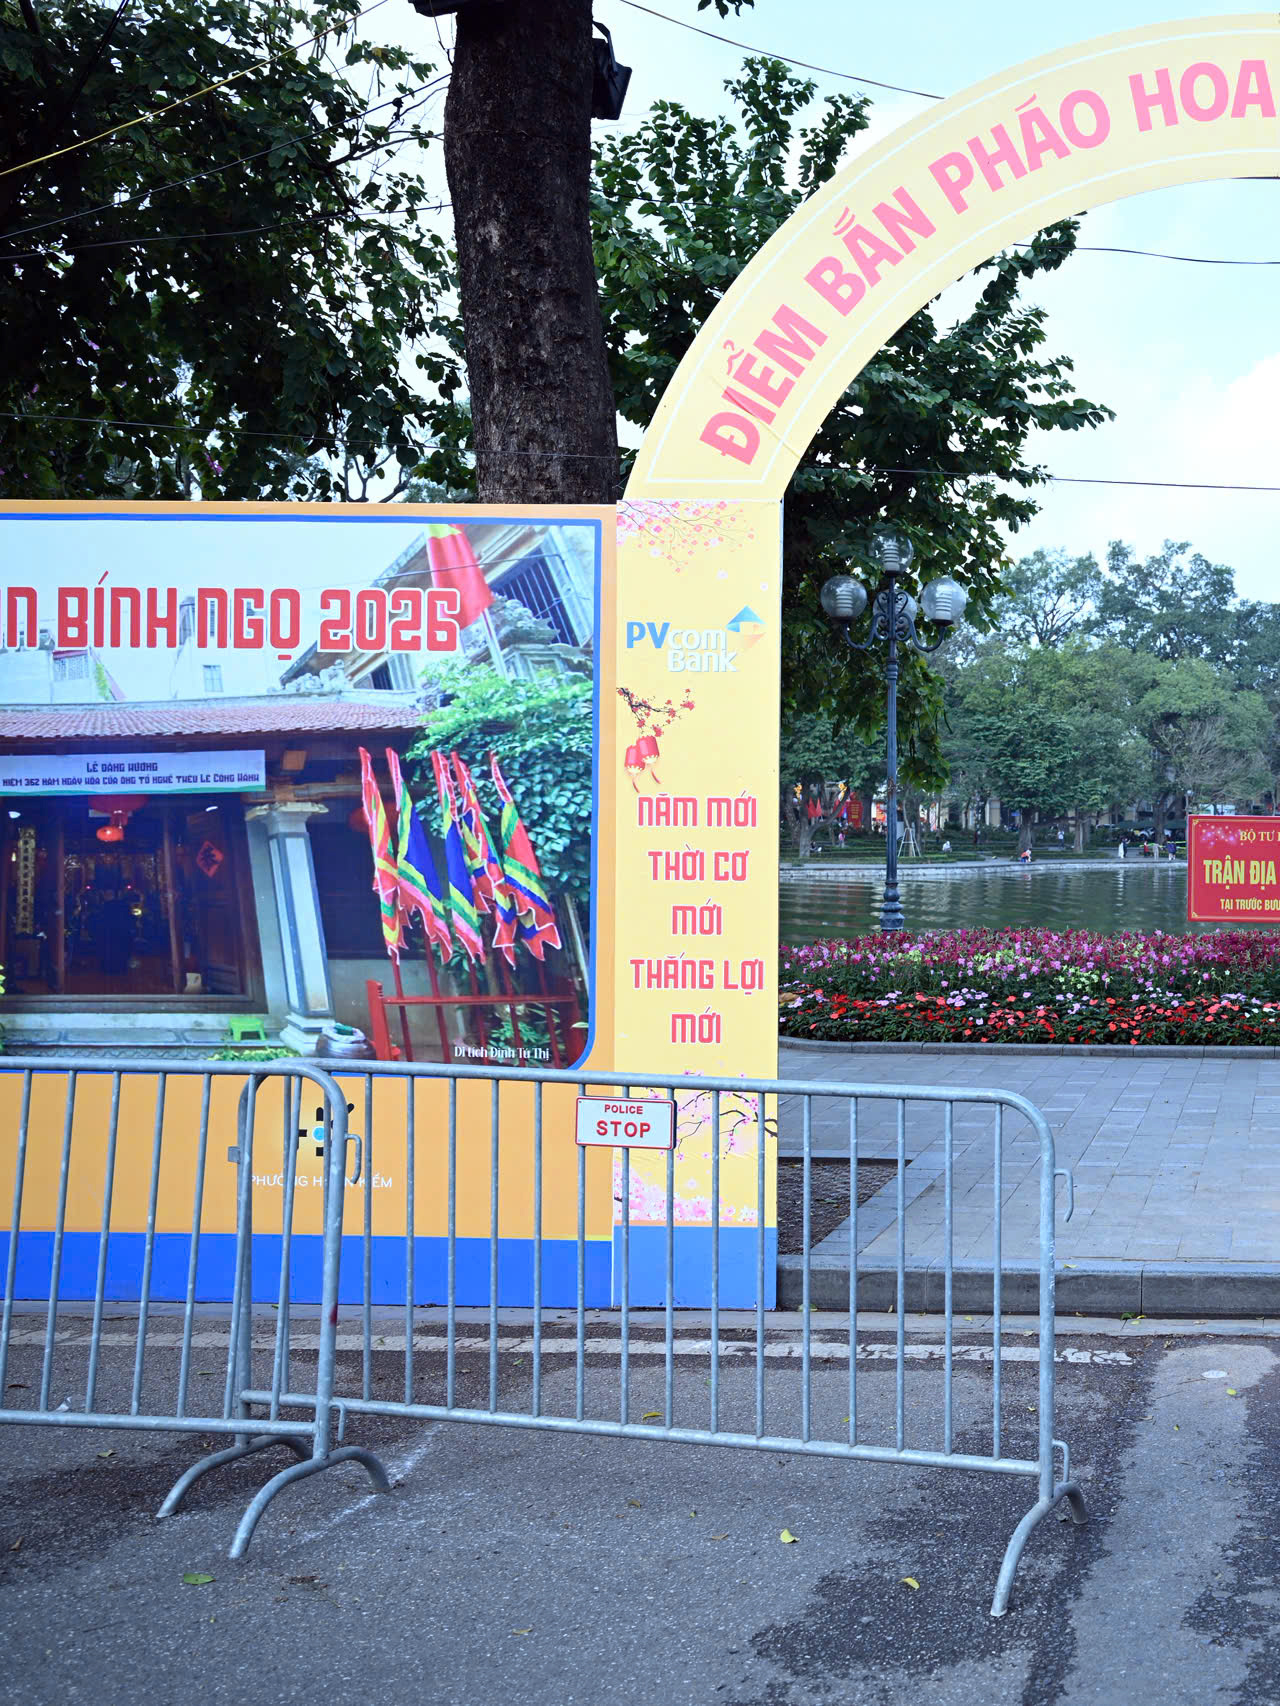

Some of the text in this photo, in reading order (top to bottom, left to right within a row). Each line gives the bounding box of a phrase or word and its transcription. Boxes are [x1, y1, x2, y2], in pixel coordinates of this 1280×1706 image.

[699, 303, 828, 465] ĐIỂM
[803, 186, 937, 317] BẮN
[928, 89, 1111, 214] PHÁO
[1129, 59, 1276, 133] HOA
[57, 570, 178, 649] BÍNH
[197, 587, 301, 661] NGỌ
[319, 589, 459, 652] 2026
[667, 650, 739, 673] Bank
[638, 790, 757, 827] NĂM MỚI
[1240, 829, 1256, 844] BỘ
[1258, 830, 1275, 842] TƯ
[648, 844, 749, 881] THỜI CƠ
[1203, 855, 1245, 890] TRẬN
[1250, 860, 1277, 890] ĐỊA
[672, 898, 722, 935] MỚI
[1220, 898, 1234, 914] TẠI
[630, 952, 764, 996] THẮNG LỢI
[671, 1006, 721, 1043] MỚI
[604, 1104, 644, 1115] POLICE
[596, 1119, 651, 1138] STOP
